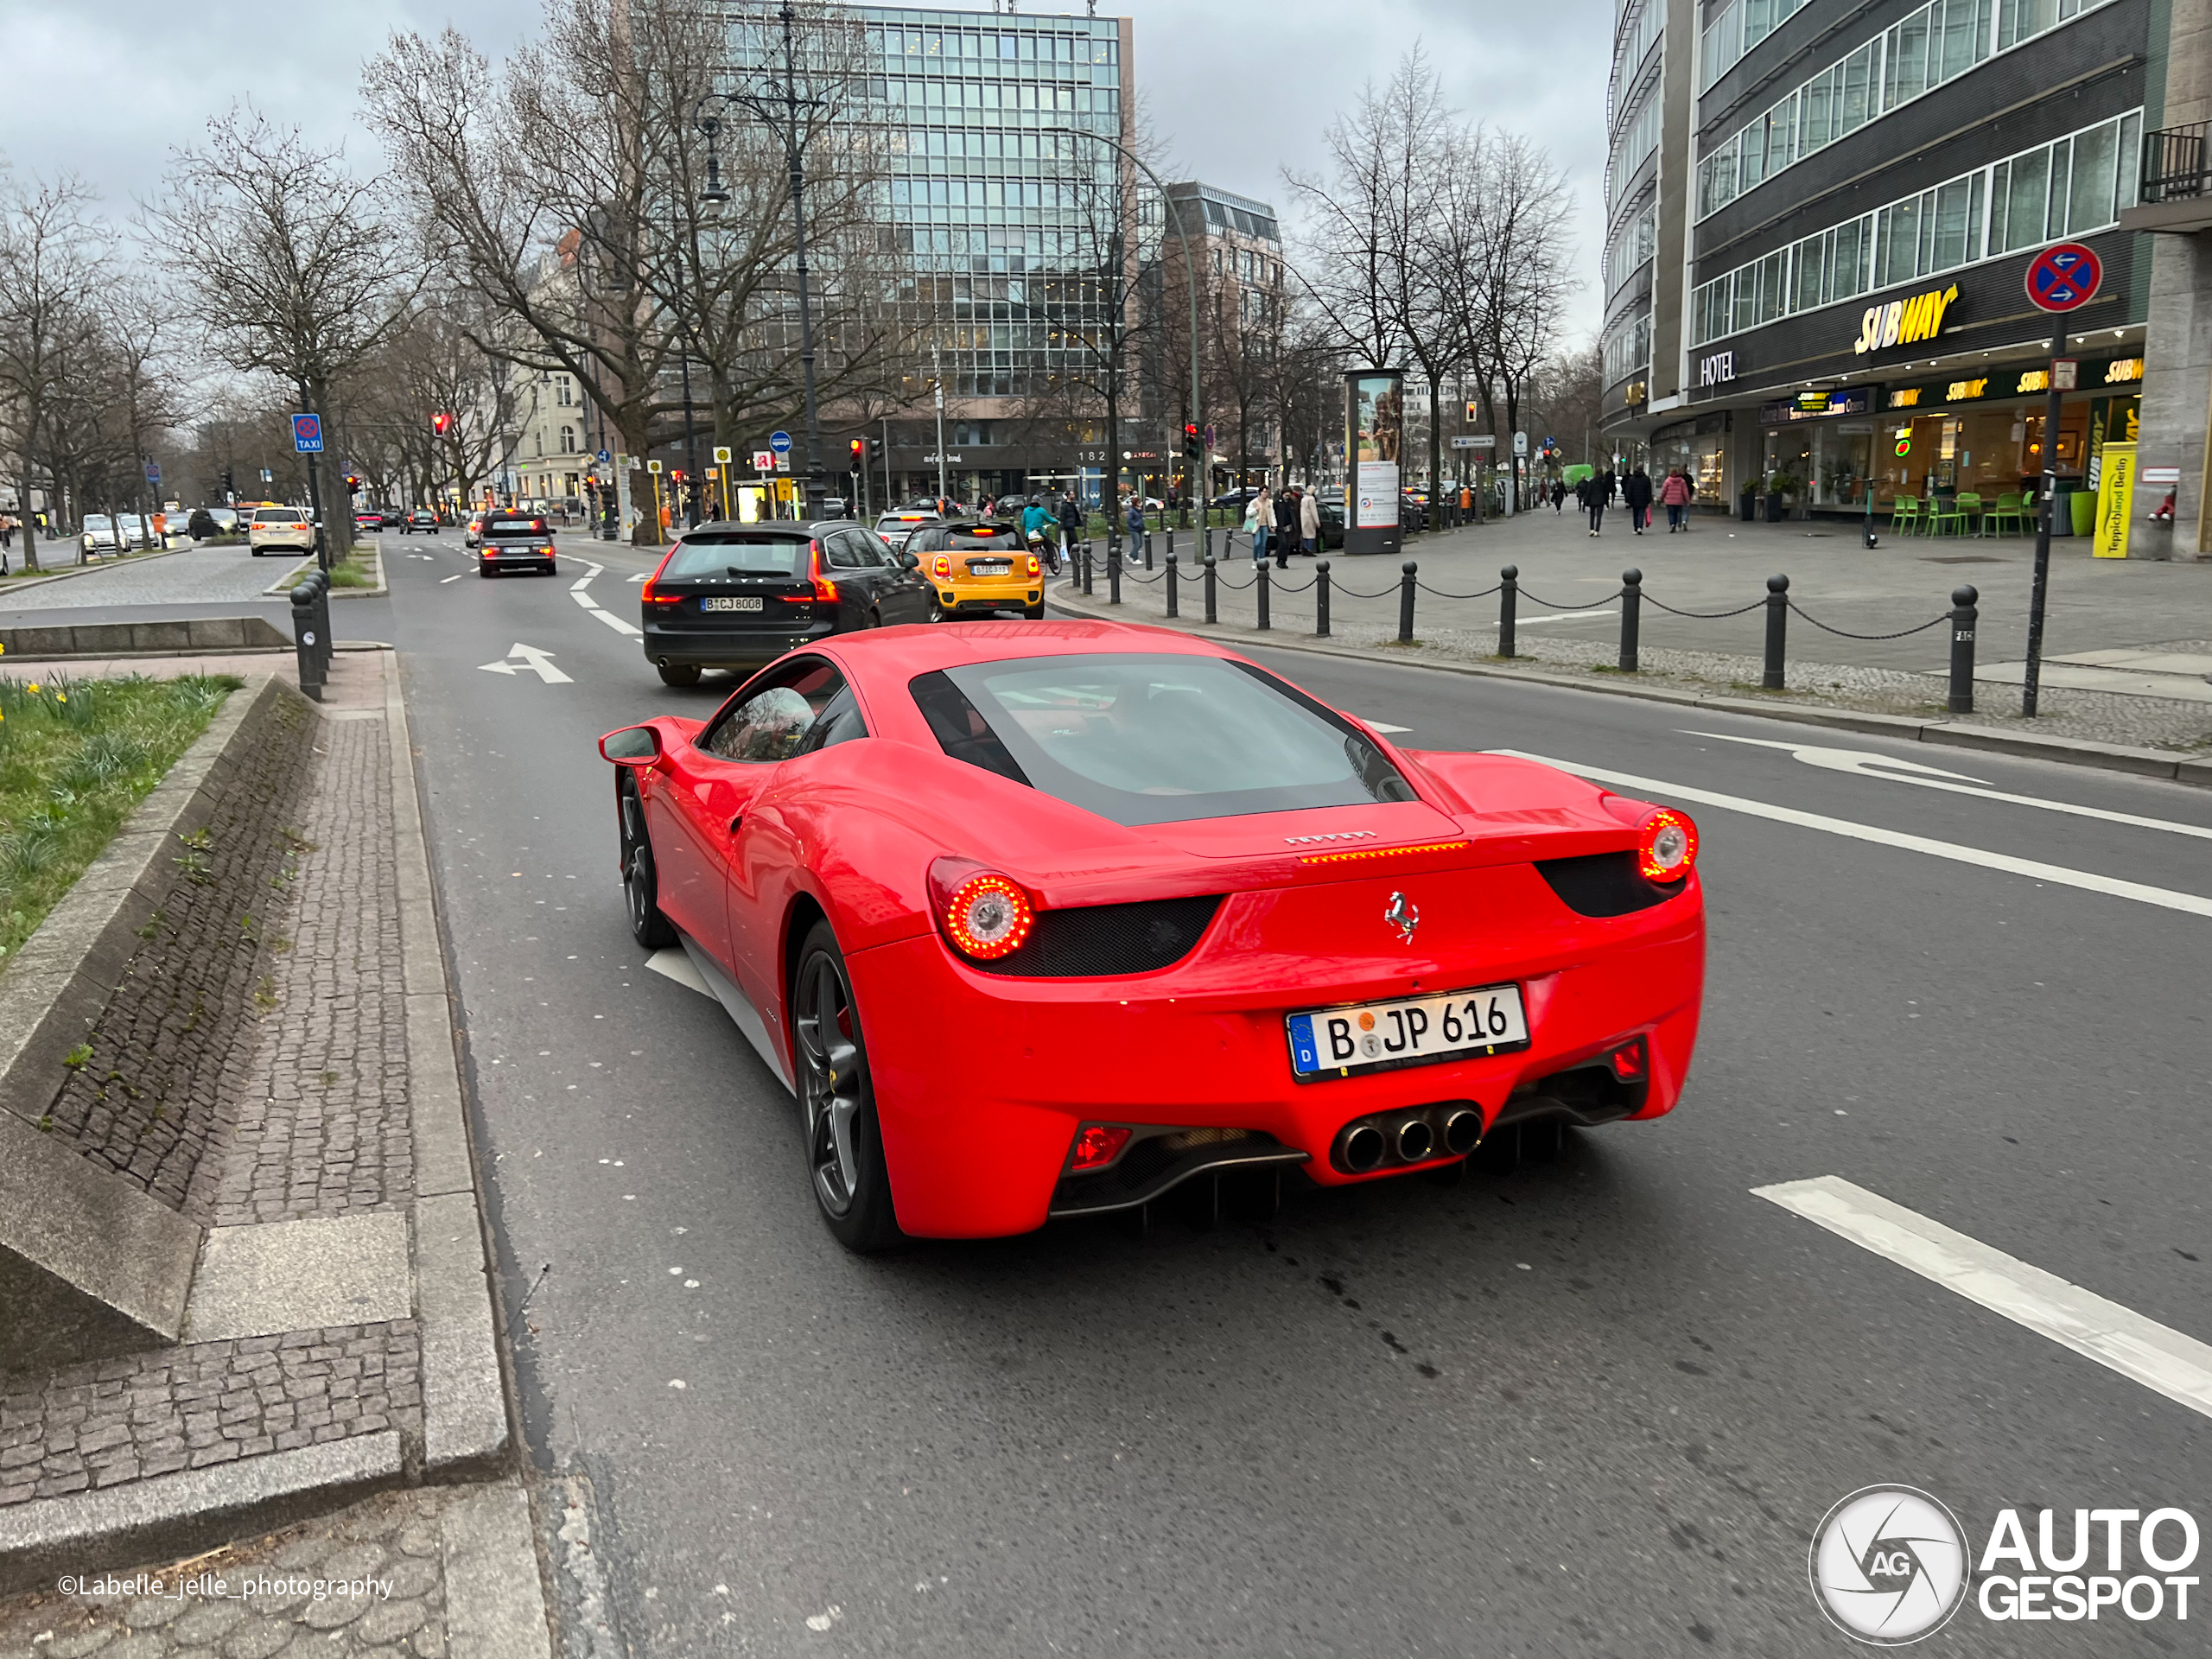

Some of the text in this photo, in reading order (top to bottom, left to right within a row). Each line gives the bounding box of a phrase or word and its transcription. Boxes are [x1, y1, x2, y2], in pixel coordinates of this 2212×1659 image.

[1854, 283, 1958, 355] SUBWAY
[1700, 350, 1736, 387] HOTEL
[2103, 358, 2145, 384] SUBW
[1946, 378, 1988, 402] SUBWAY
[2016, 370, 2050, 393] SUBW
[1888, 388, 1922, 408] SUBWAY
[298, 440, 321, 449] TAXI
[1078, 451, 1105, 461] 182
[2108, 458, 2128, 553] Teppichland Berlin
[707, 599, 761, 609] B CJ 8008
[1327, 1018, 1355, 1061] B
[1384, 1007, 1428, 1052] JP
[1442, 997, 1507, 1043] 616
